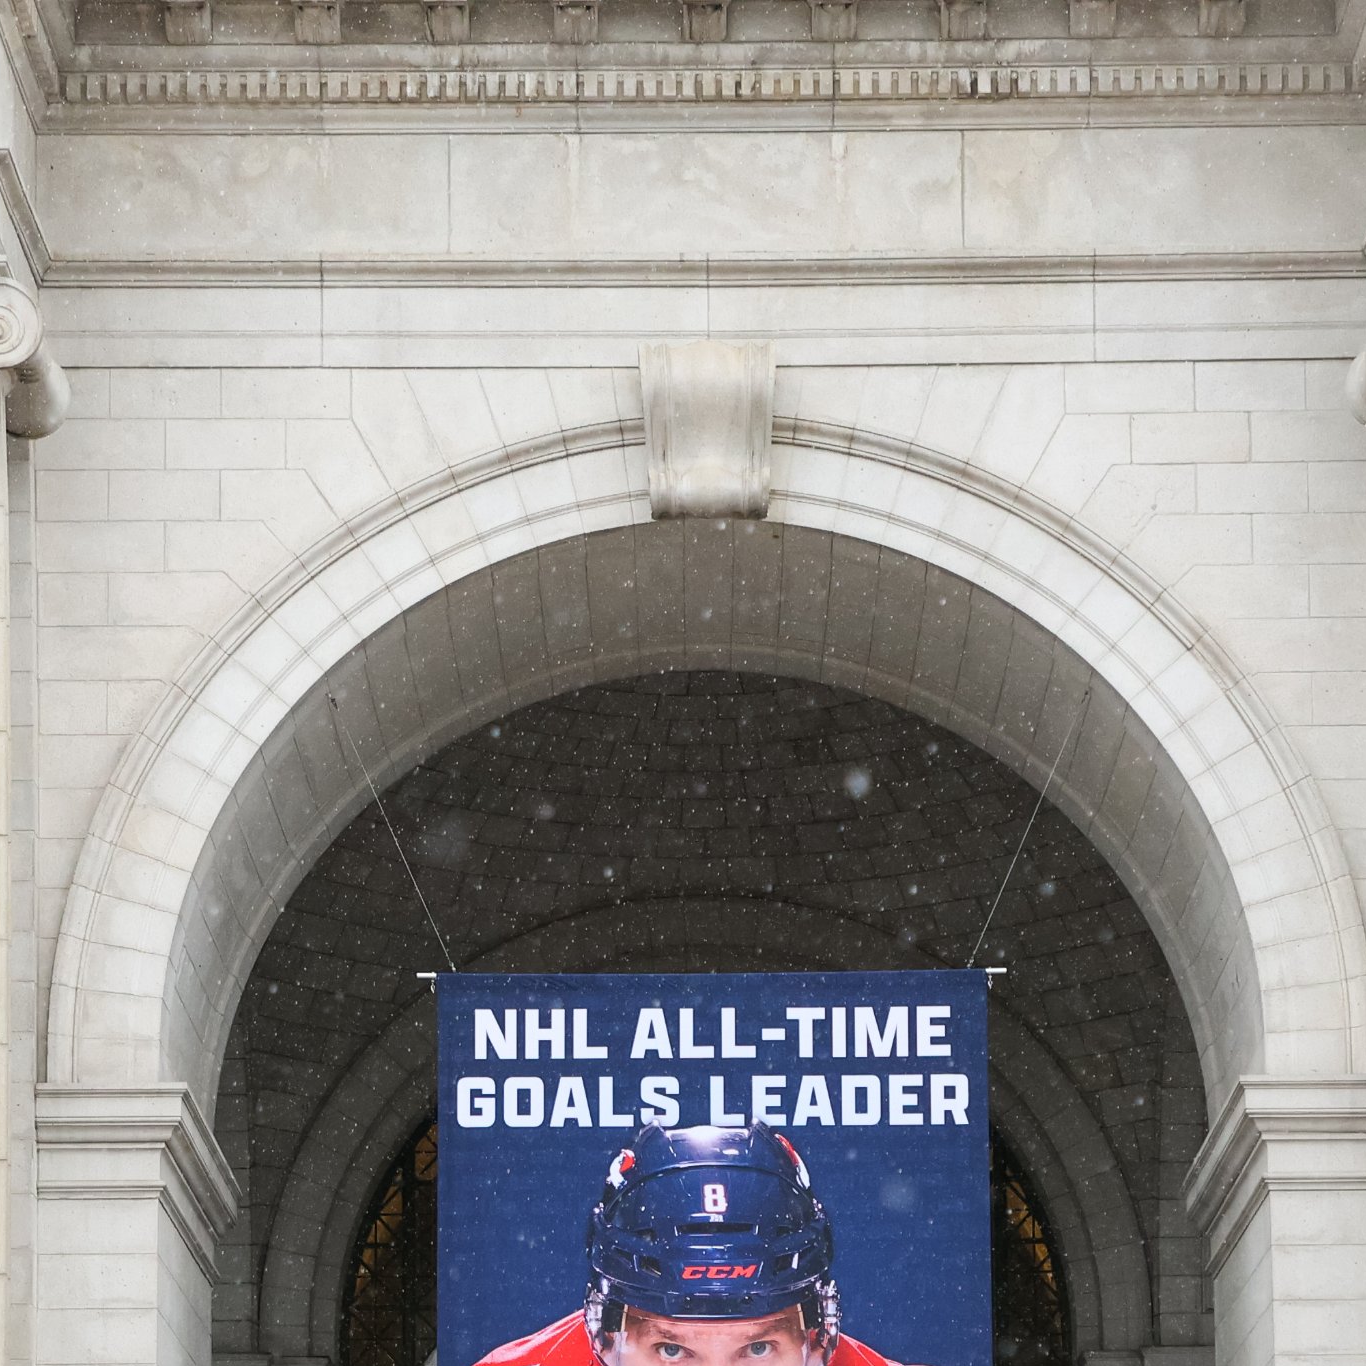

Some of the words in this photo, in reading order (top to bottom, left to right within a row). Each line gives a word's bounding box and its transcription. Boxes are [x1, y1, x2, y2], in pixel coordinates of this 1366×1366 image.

[474, 1008, 608, 1059] NHL
[630, 1005, 952, 1059] ALL-TIME
[456, 1076, 680, 1128] GOALS
[709, 1073, 969, 1127] LEADER
[702, 1184, 728, 1213] 8
[682, 1265, 758, 1279] CCM
